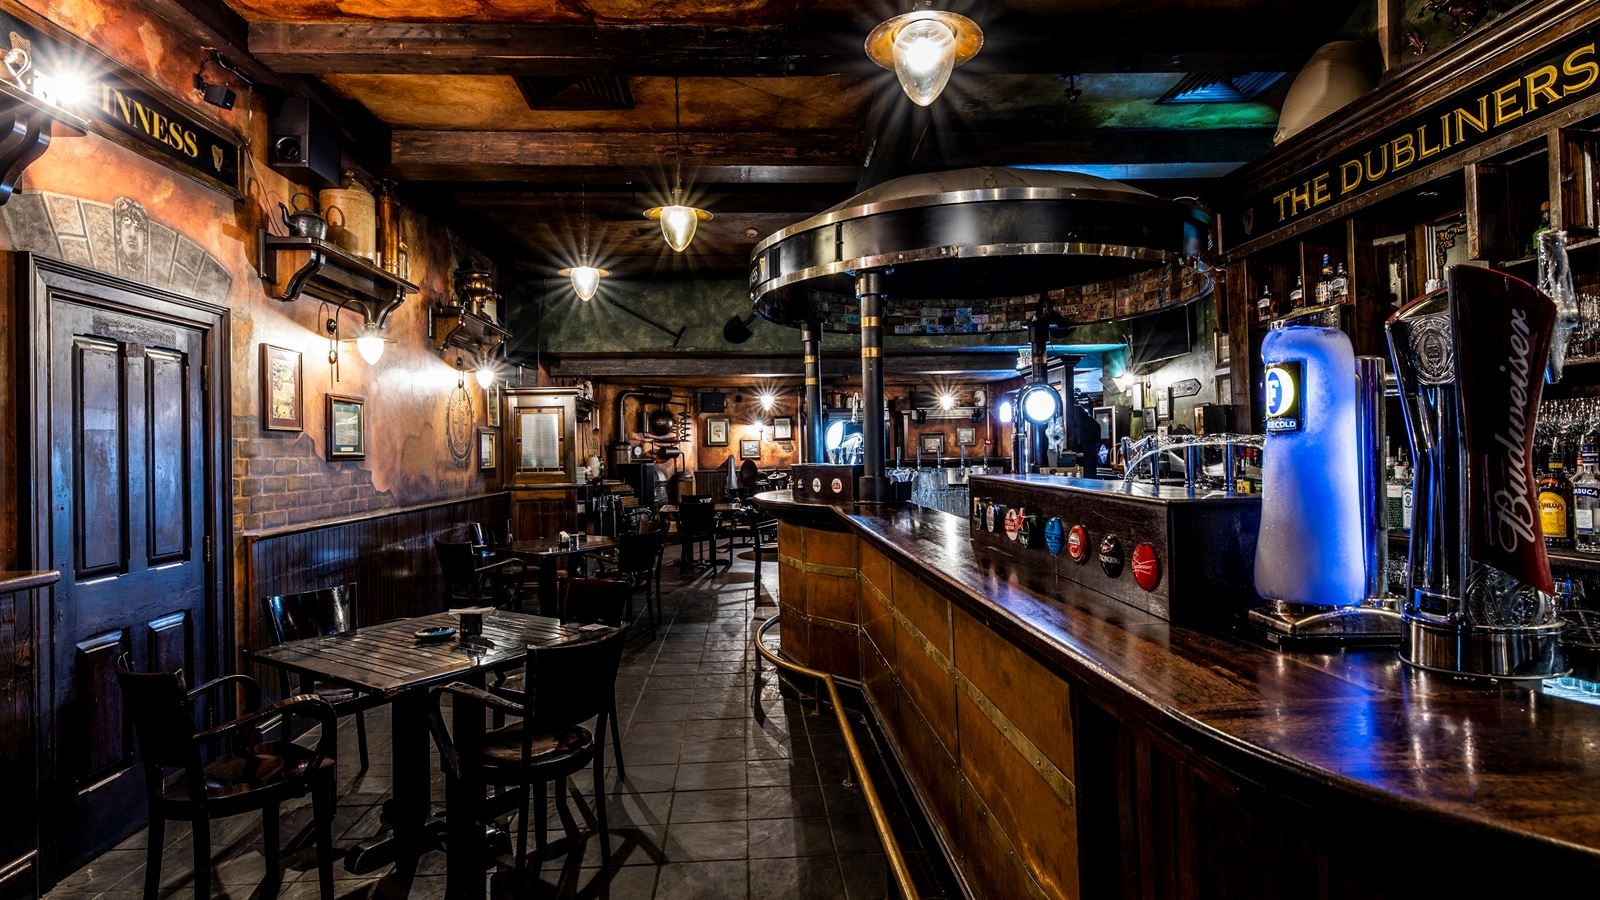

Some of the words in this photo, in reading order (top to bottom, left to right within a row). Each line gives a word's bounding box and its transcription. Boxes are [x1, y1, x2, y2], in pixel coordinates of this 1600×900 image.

[100, 82, 198, 158] INNESS
[1273, 173, 1331, 222] THE
[1340, 43, 1599, 195] DUBLINERS
[1494, 307, 1536, 553] Budweiser
